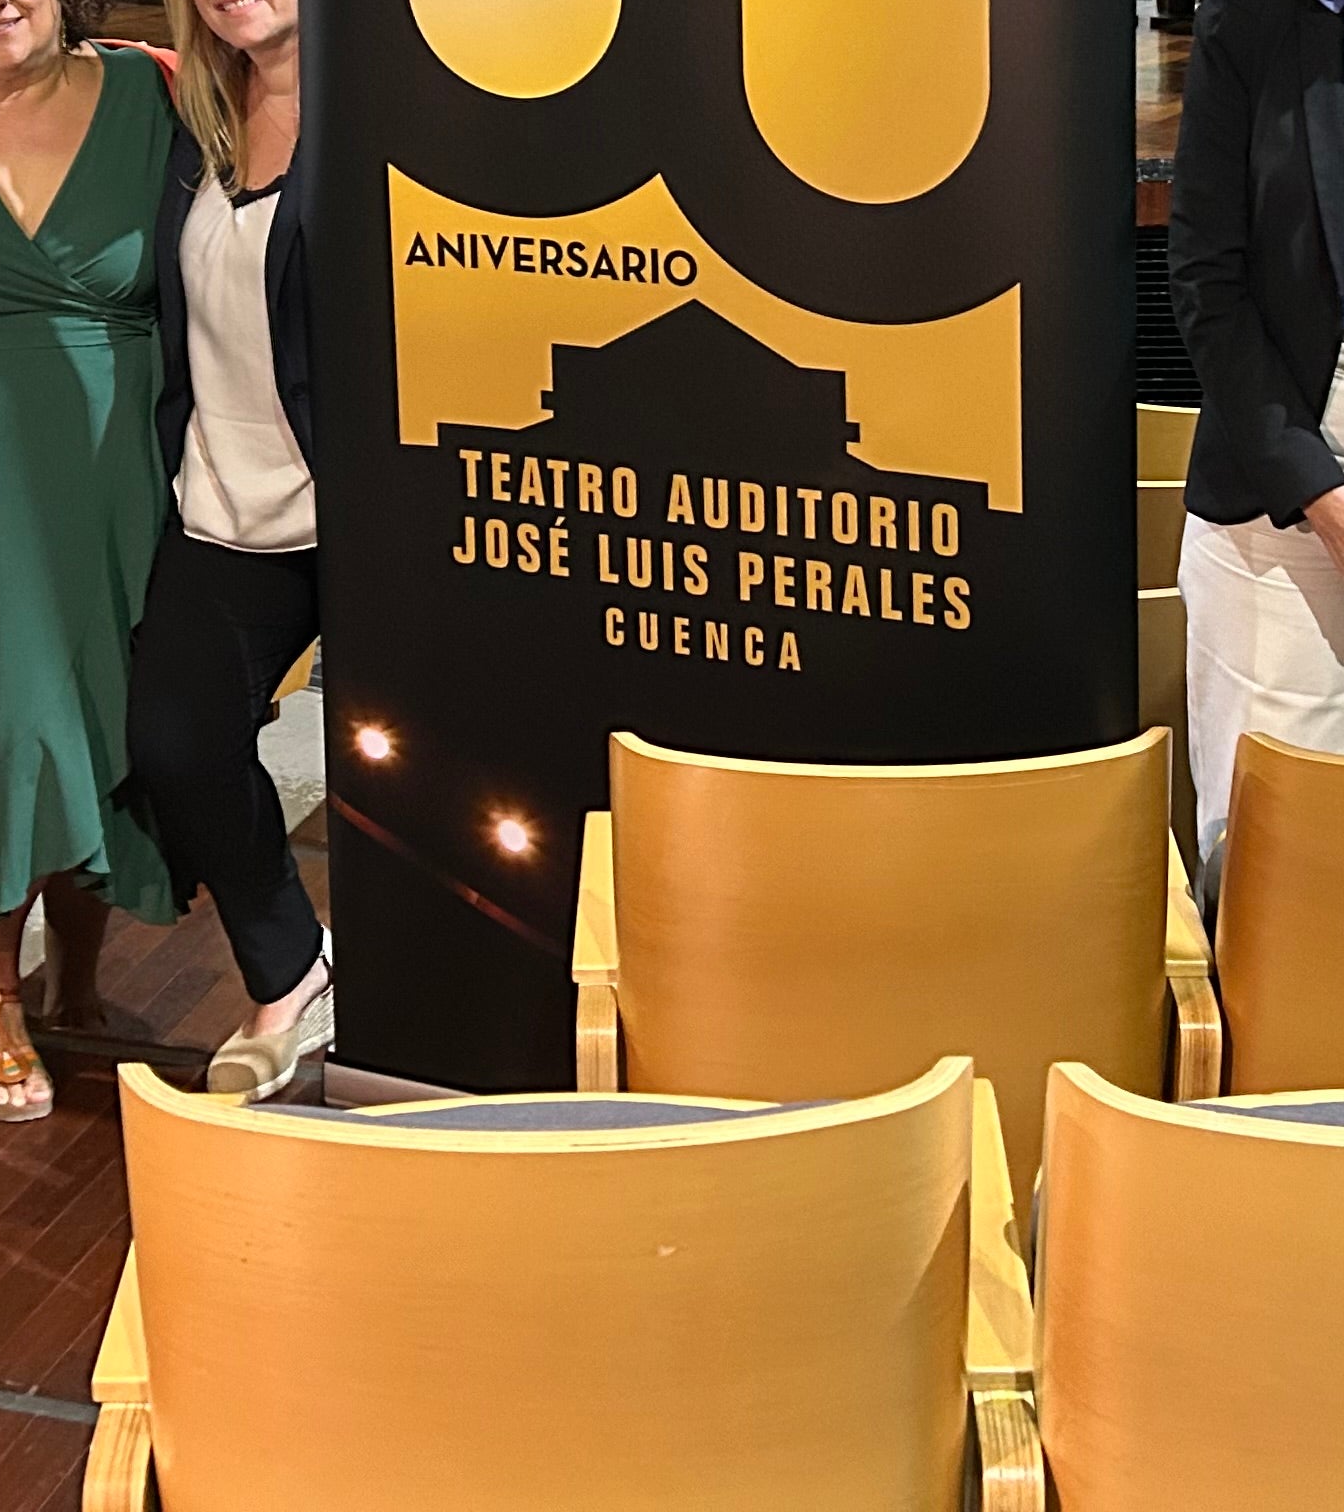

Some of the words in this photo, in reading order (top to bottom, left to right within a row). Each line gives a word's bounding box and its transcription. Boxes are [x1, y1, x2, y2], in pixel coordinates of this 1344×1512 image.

[404, 230, 699, 288] ANIVERSARIO
[459, 448, 638, 519] TEATRO
[666, 473, 960, 558] AUDITORIO
[452, 515, 570, 578] JOSÉ
[598, 533, 710, 596] LUIS
[738, 551, 972, 631] PERALES
[605, 607, 803, 672] CUENCA
